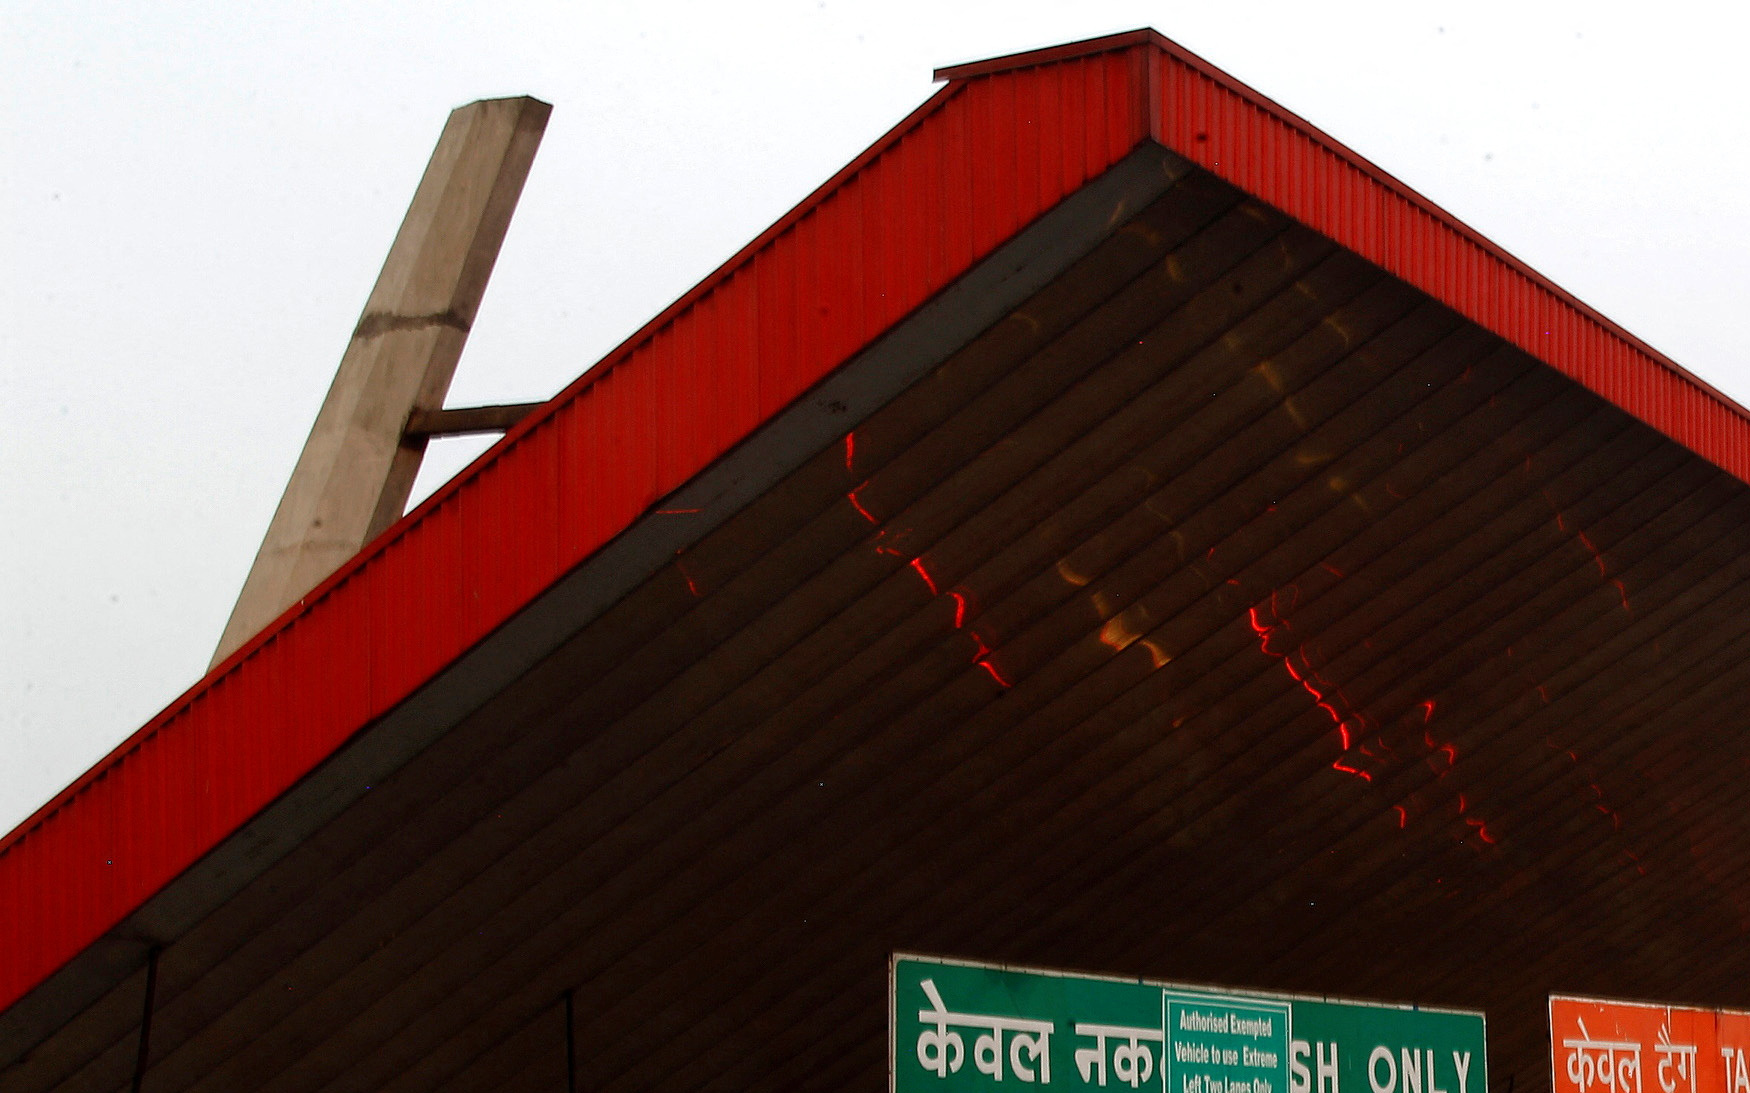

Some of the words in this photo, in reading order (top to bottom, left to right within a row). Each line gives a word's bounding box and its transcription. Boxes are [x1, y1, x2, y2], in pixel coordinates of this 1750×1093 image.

[917, 978, 1054, 1085] केवल
[1074, 1021, 1163, 1089] नक
[1179, 1009, 1229, 1034] Authorised
[1230, 1012, 1273, 1041] Exempted
[1174, 1041, 1209, 1064] Vehicle
[1211, 1044, 1221, 1065] to
[1222, 1050, 1239, 1066] use
[1243, 1046, 1278, 1069] Extreme
